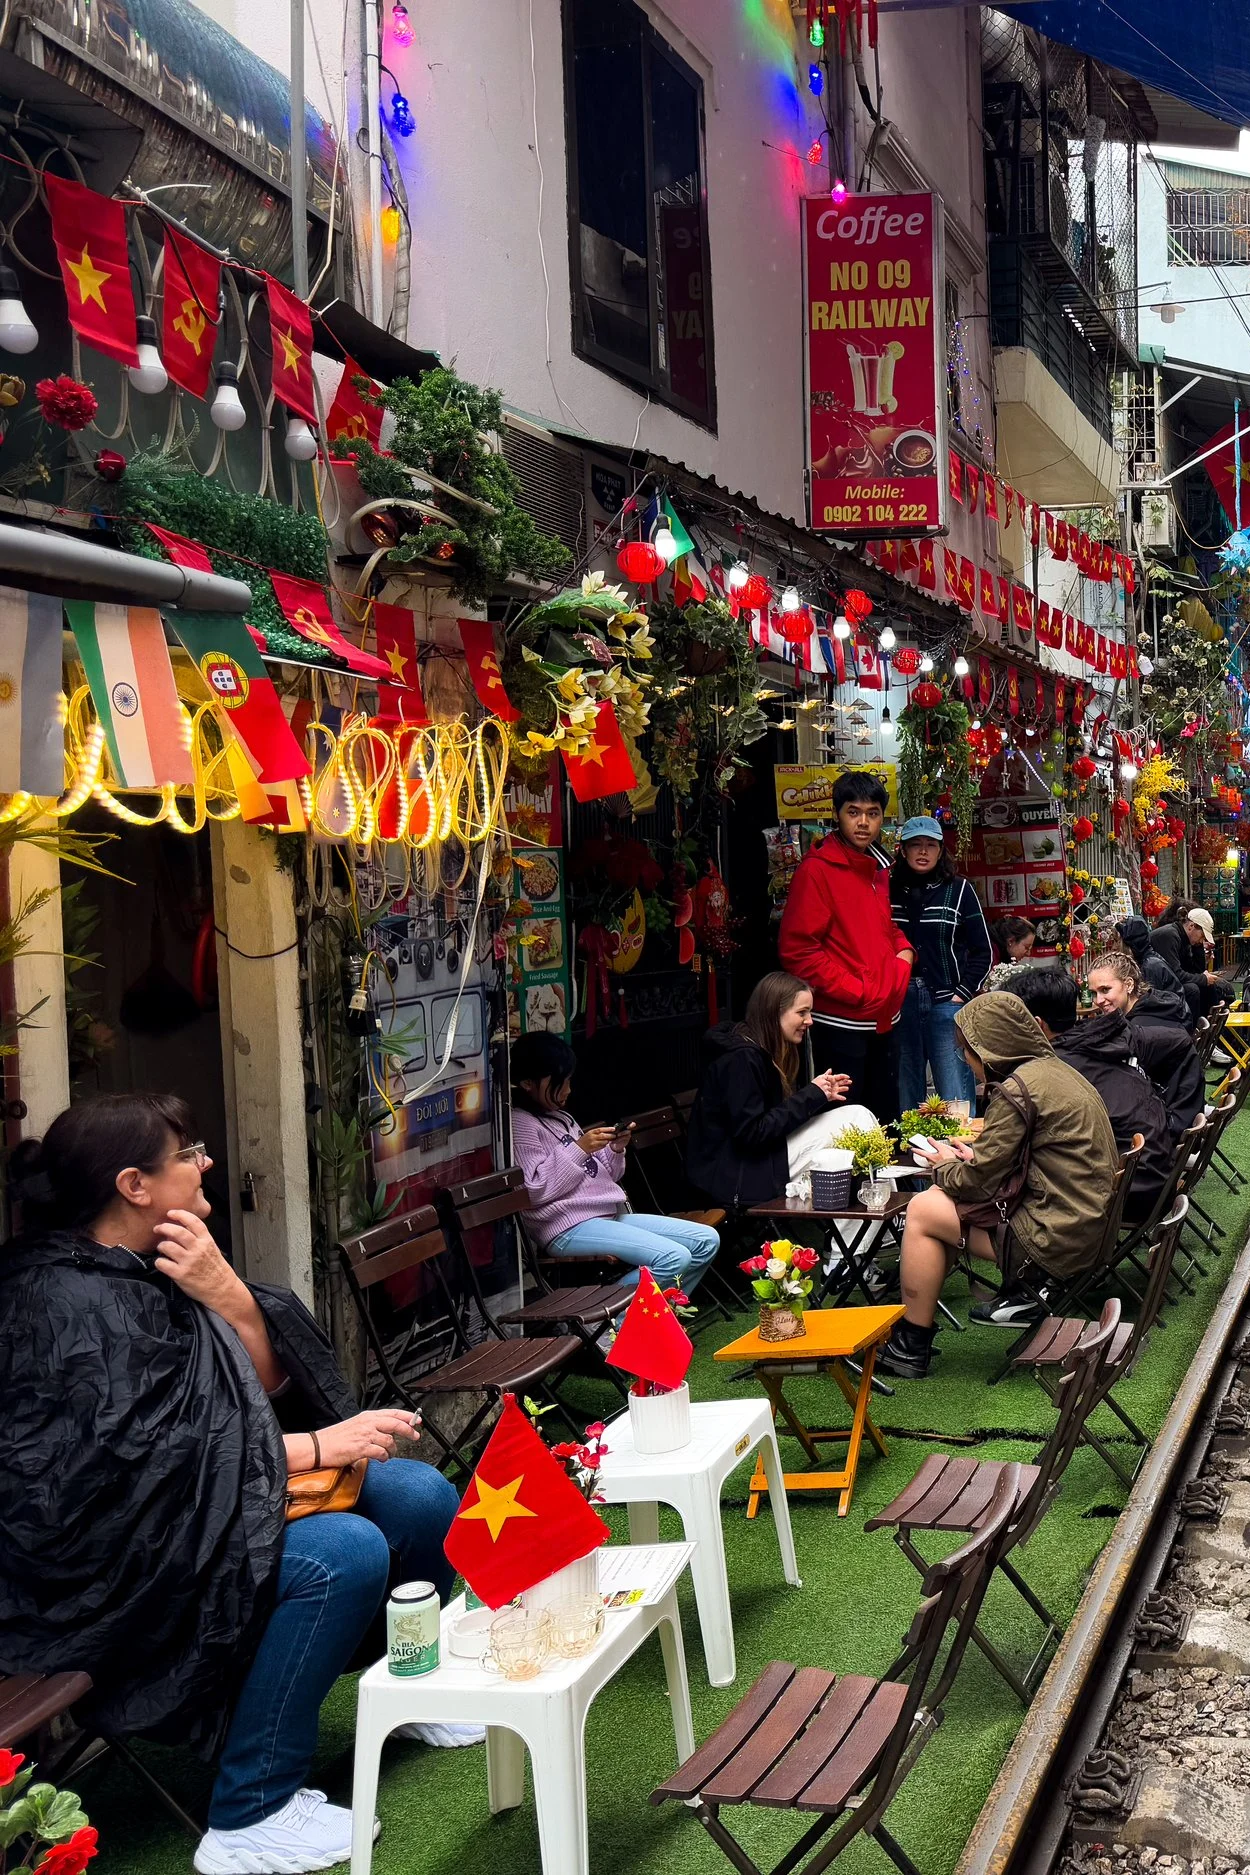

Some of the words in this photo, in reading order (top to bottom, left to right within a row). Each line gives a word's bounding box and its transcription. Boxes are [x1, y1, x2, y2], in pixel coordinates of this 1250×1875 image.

[816, 206, 925, 245] Coffee
[830, 261, 869, 291] NO
[877, 259, 911, 289] 09
[811, 297, 931, 331] RAILWAY
[845, 484, 905, 499] Mobile:
[823, 505, 862, 523] 0902
[866, 504, 895, 521] 104
[899, 504, 928, 521] 222
[390, 1643, 431, 1657] SAIGON
